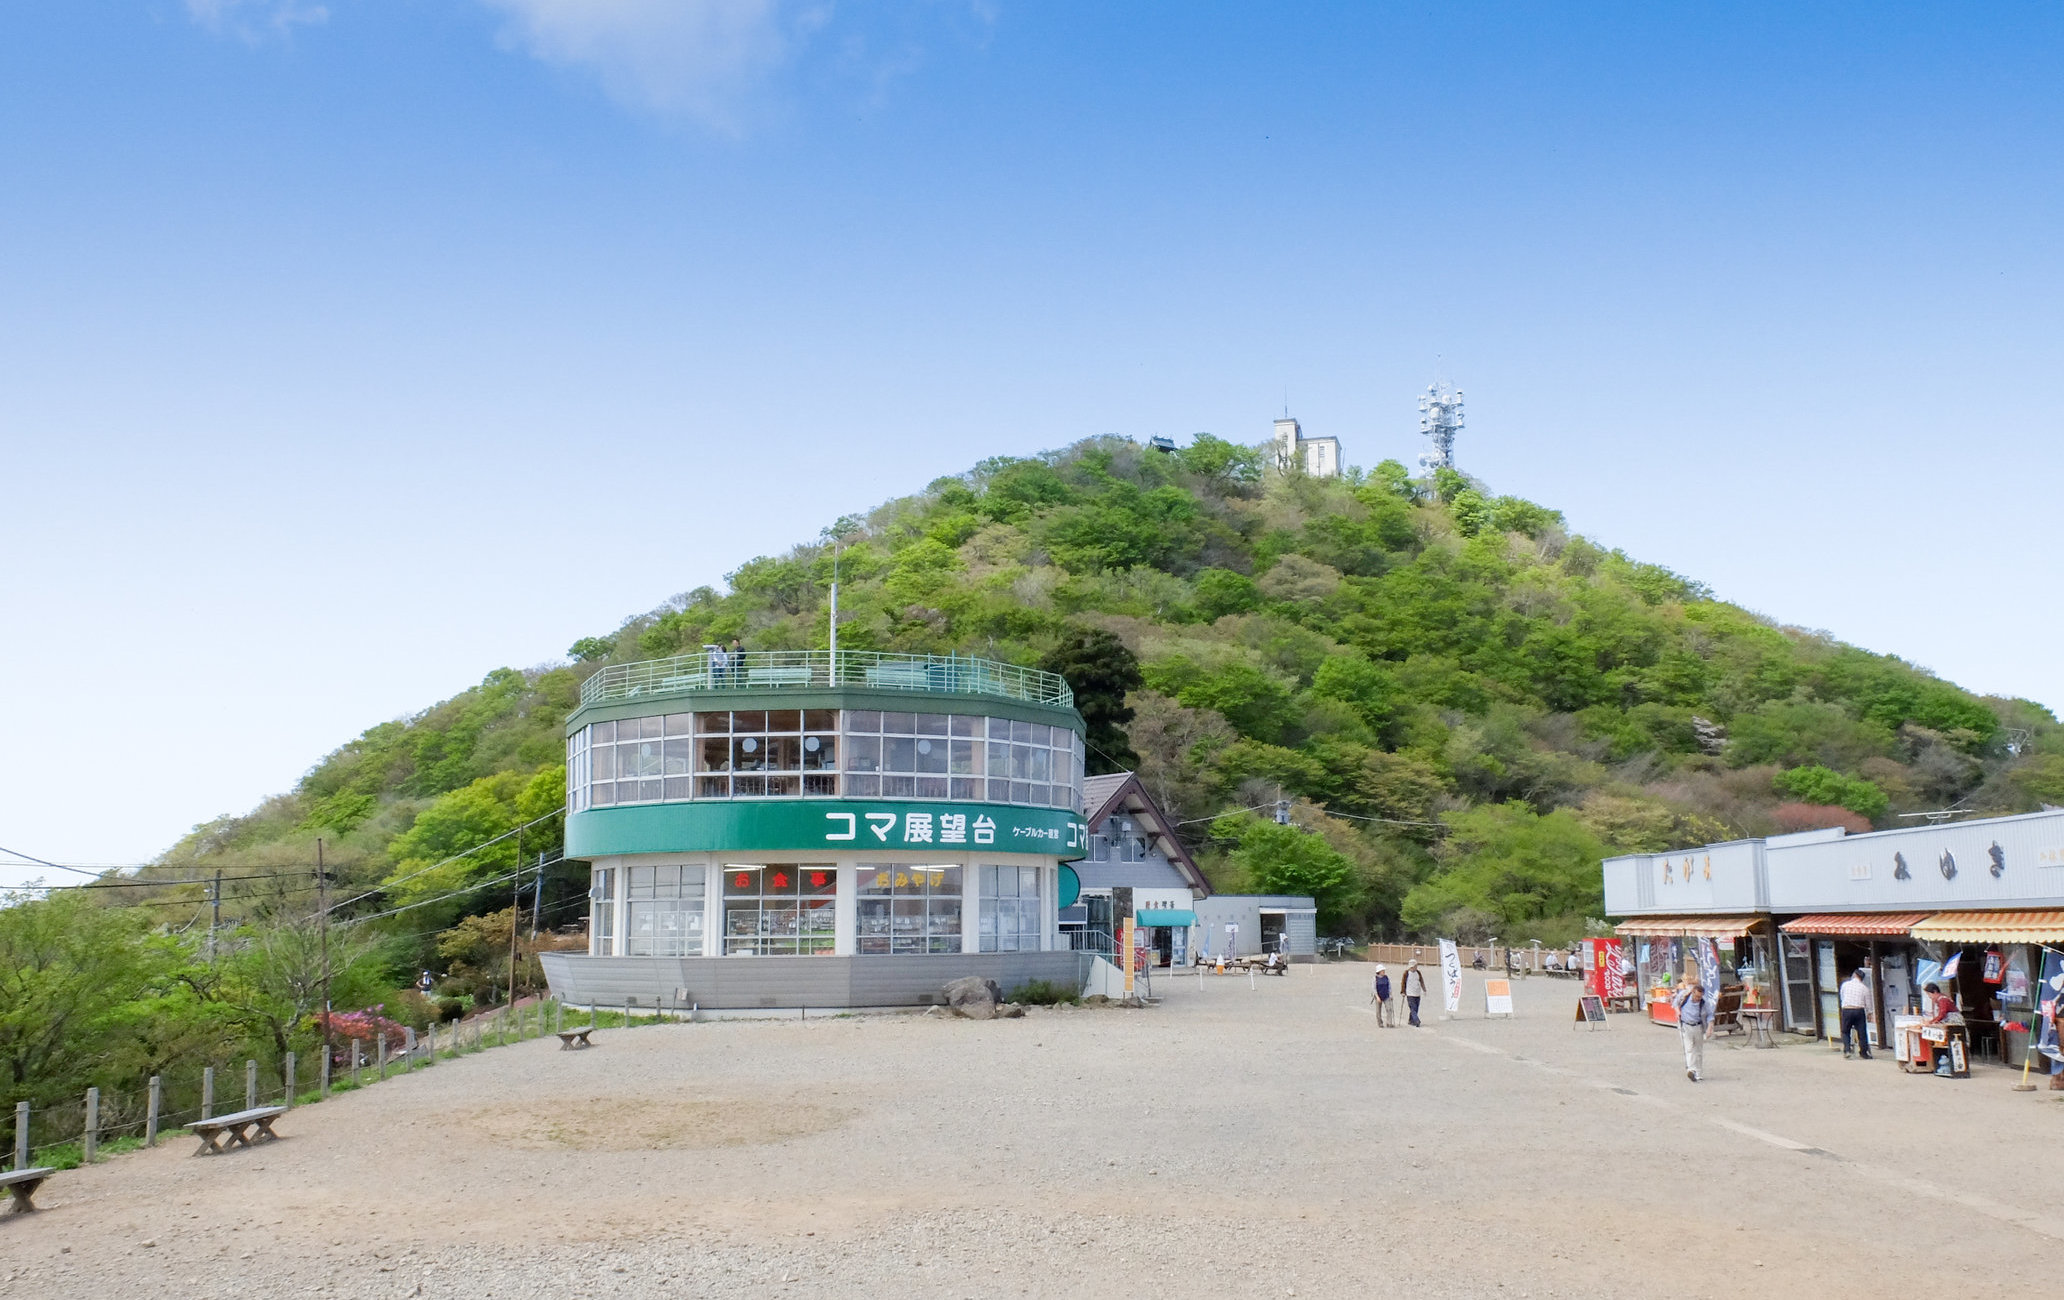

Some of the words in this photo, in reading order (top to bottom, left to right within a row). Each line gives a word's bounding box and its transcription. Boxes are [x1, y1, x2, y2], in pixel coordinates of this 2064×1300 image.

[825, 812, 997, 844] コマ展望台
[1067, 822, 1088, 850] コマ
[734, 872, 827, 887] お食事
[876, 872, 945, 887] おみやげ
